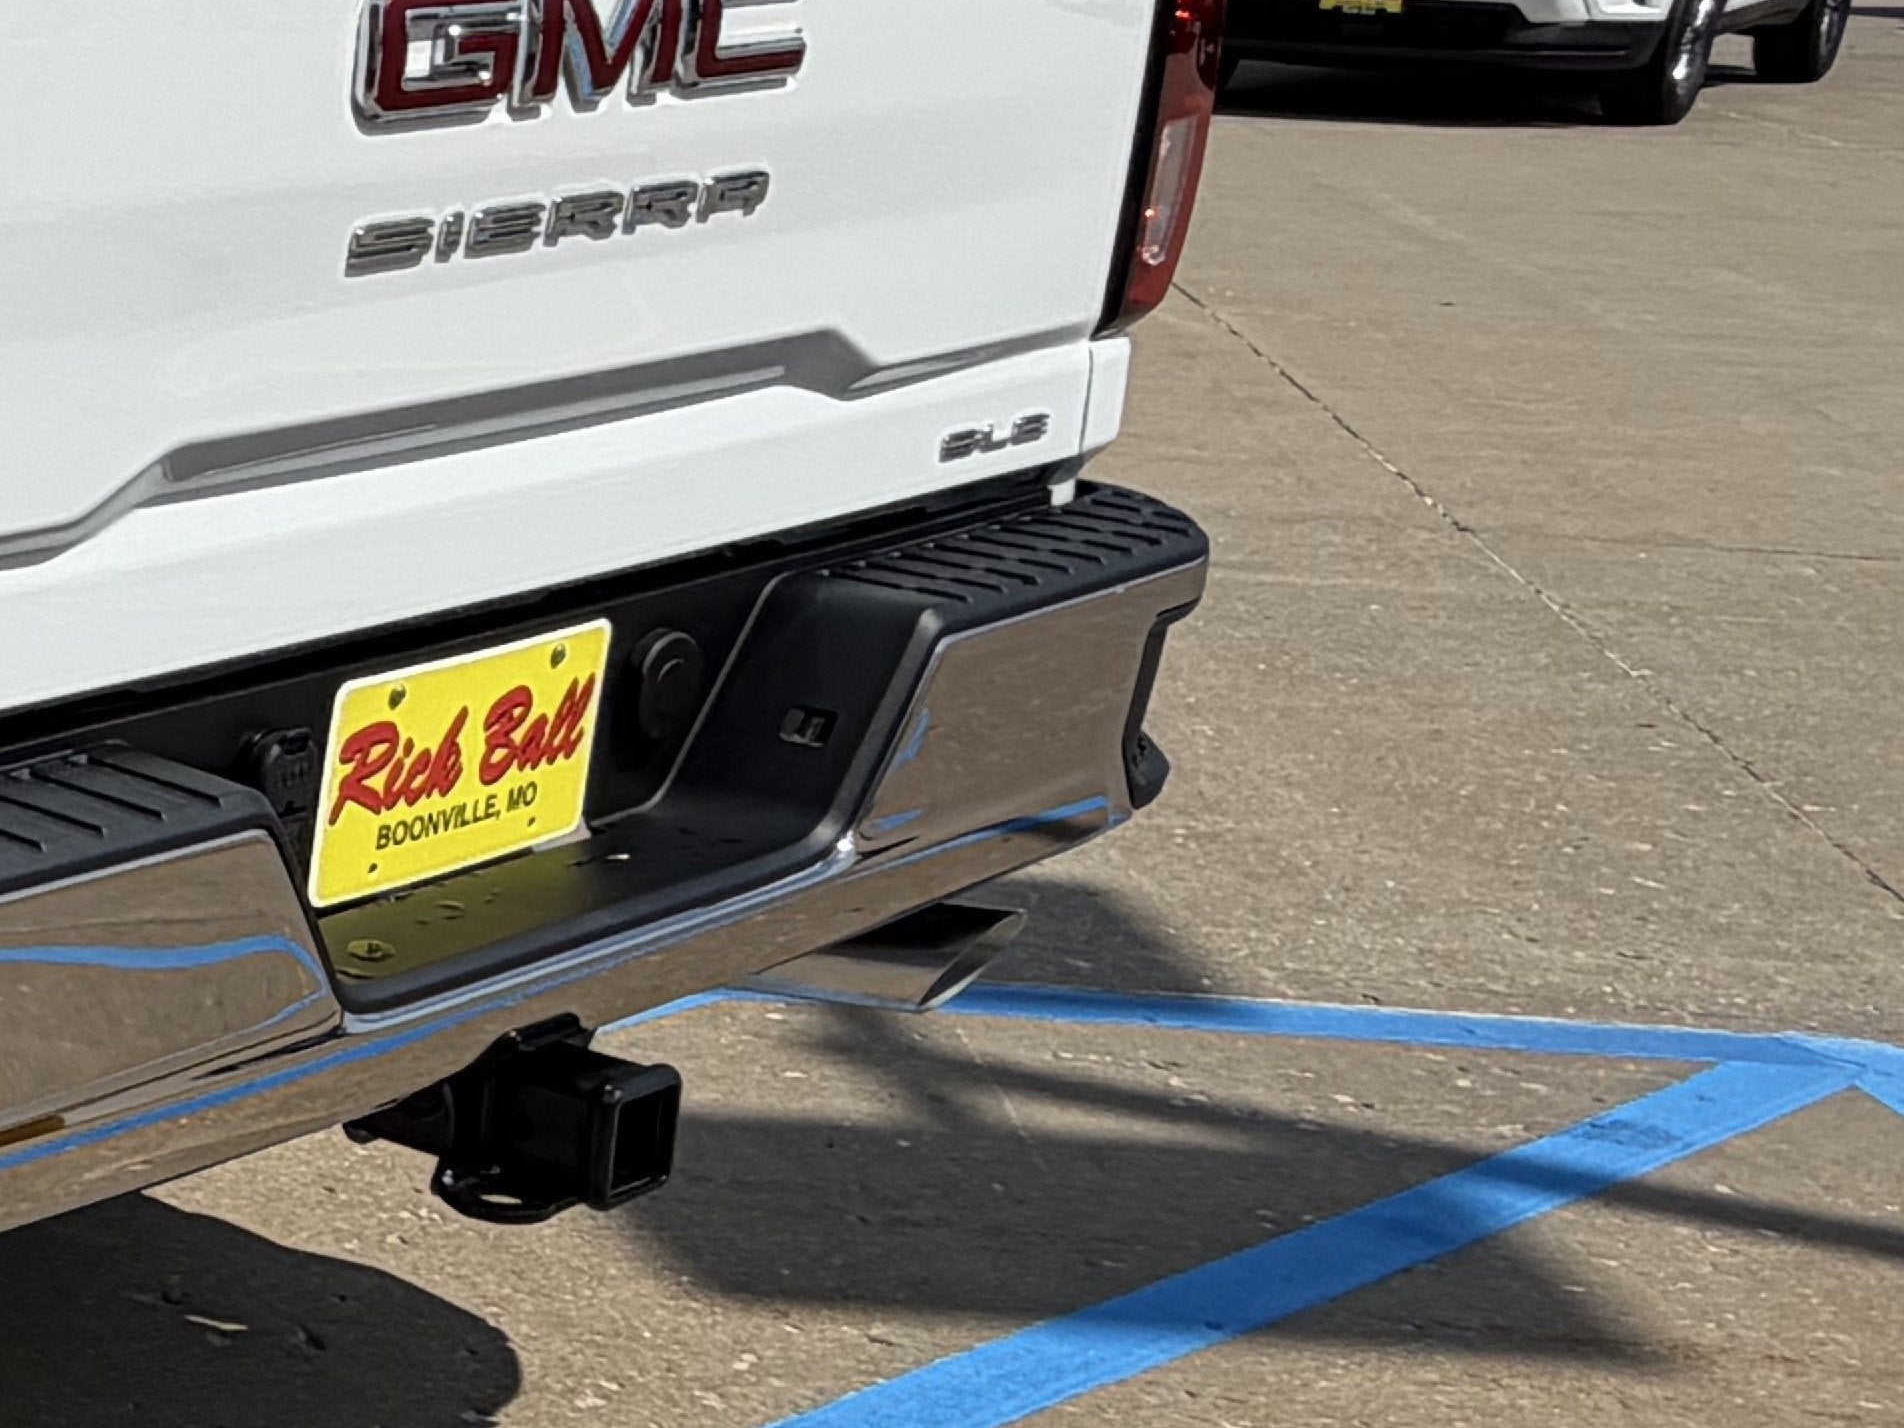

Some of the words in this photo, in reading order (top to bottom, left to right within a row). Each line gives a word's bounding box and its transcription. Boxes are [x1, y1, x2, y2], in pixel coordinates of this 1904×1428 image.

[343, 170, 771, 278] SIERRA
[327, 704, 470, 827] Rick
[478, 671, 596, 786] Ball
[375, 793, 501, 851] BOONVILLE,
[506, 780, 538, 813] MO
